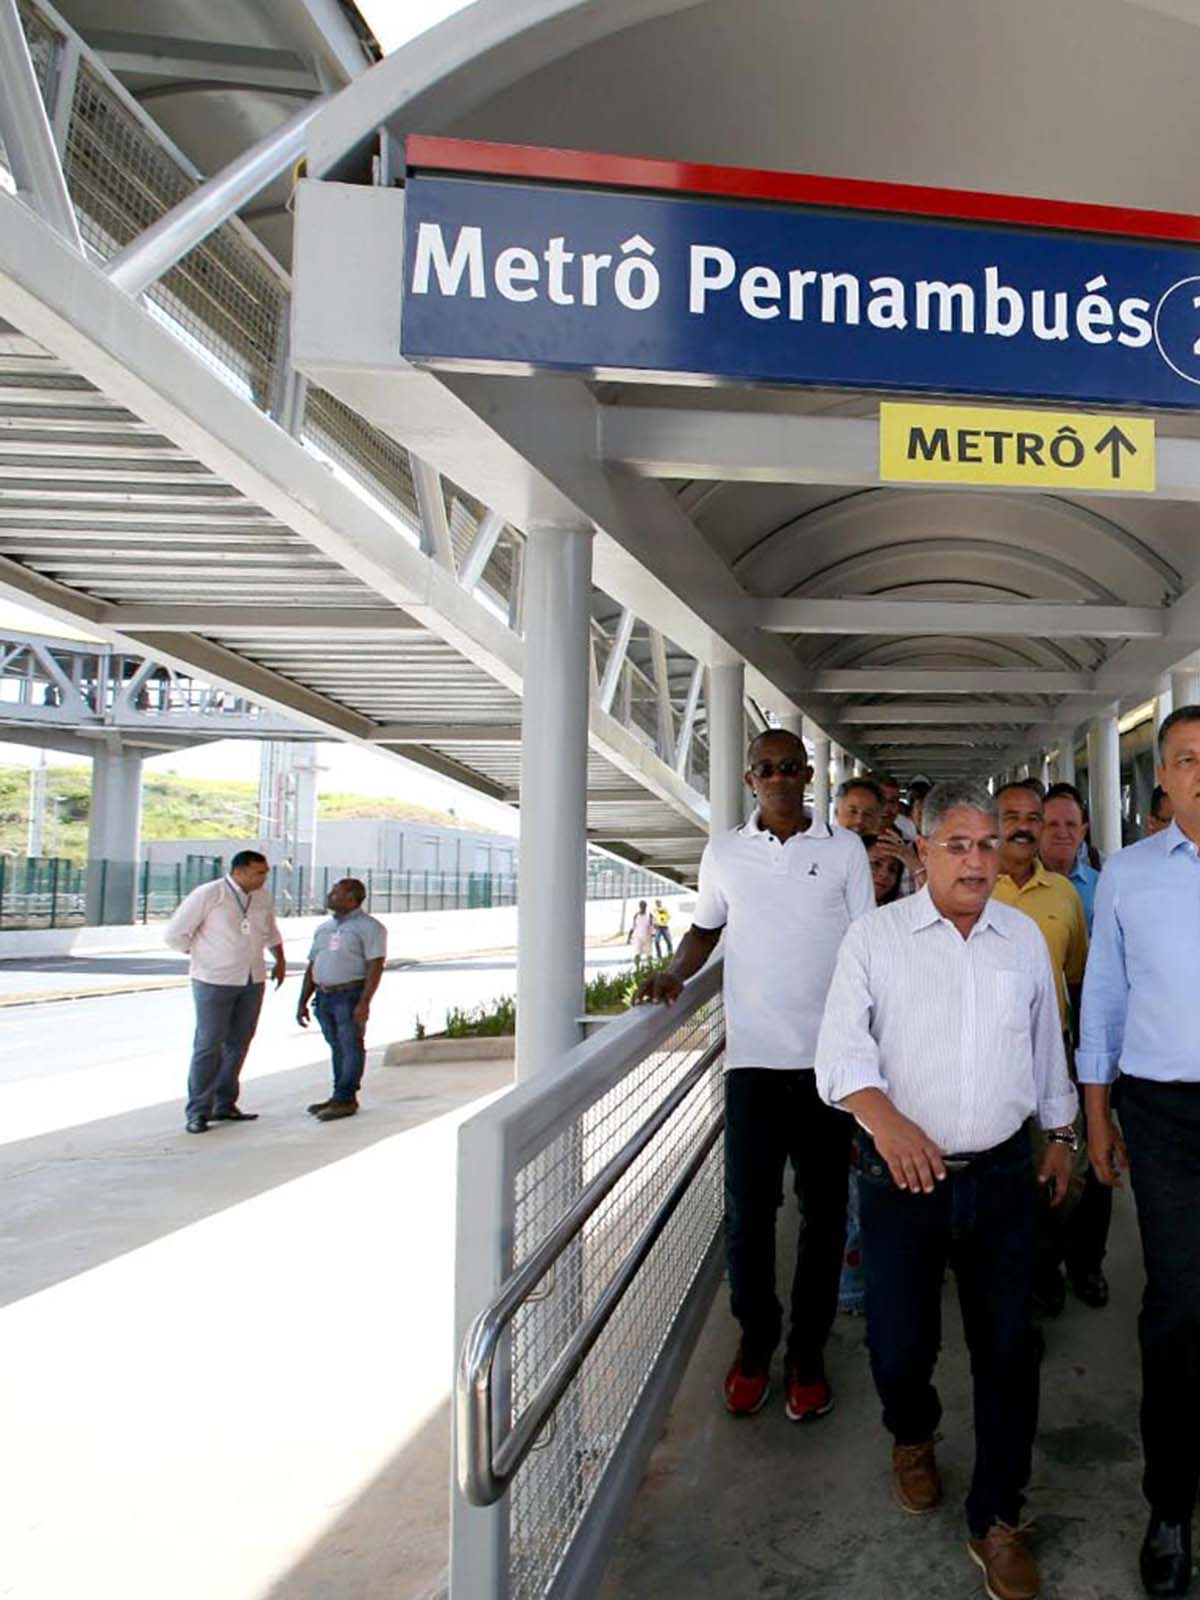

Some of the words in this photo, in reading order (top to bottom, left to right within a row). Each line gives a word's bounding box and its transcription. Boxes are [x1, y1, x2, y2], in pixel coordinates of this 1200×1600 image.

[411, 222, 661, 312] Metrô
[688, 244, 1154, 348] Pernambués
[906, 425, 1086, 469] METRÔ
